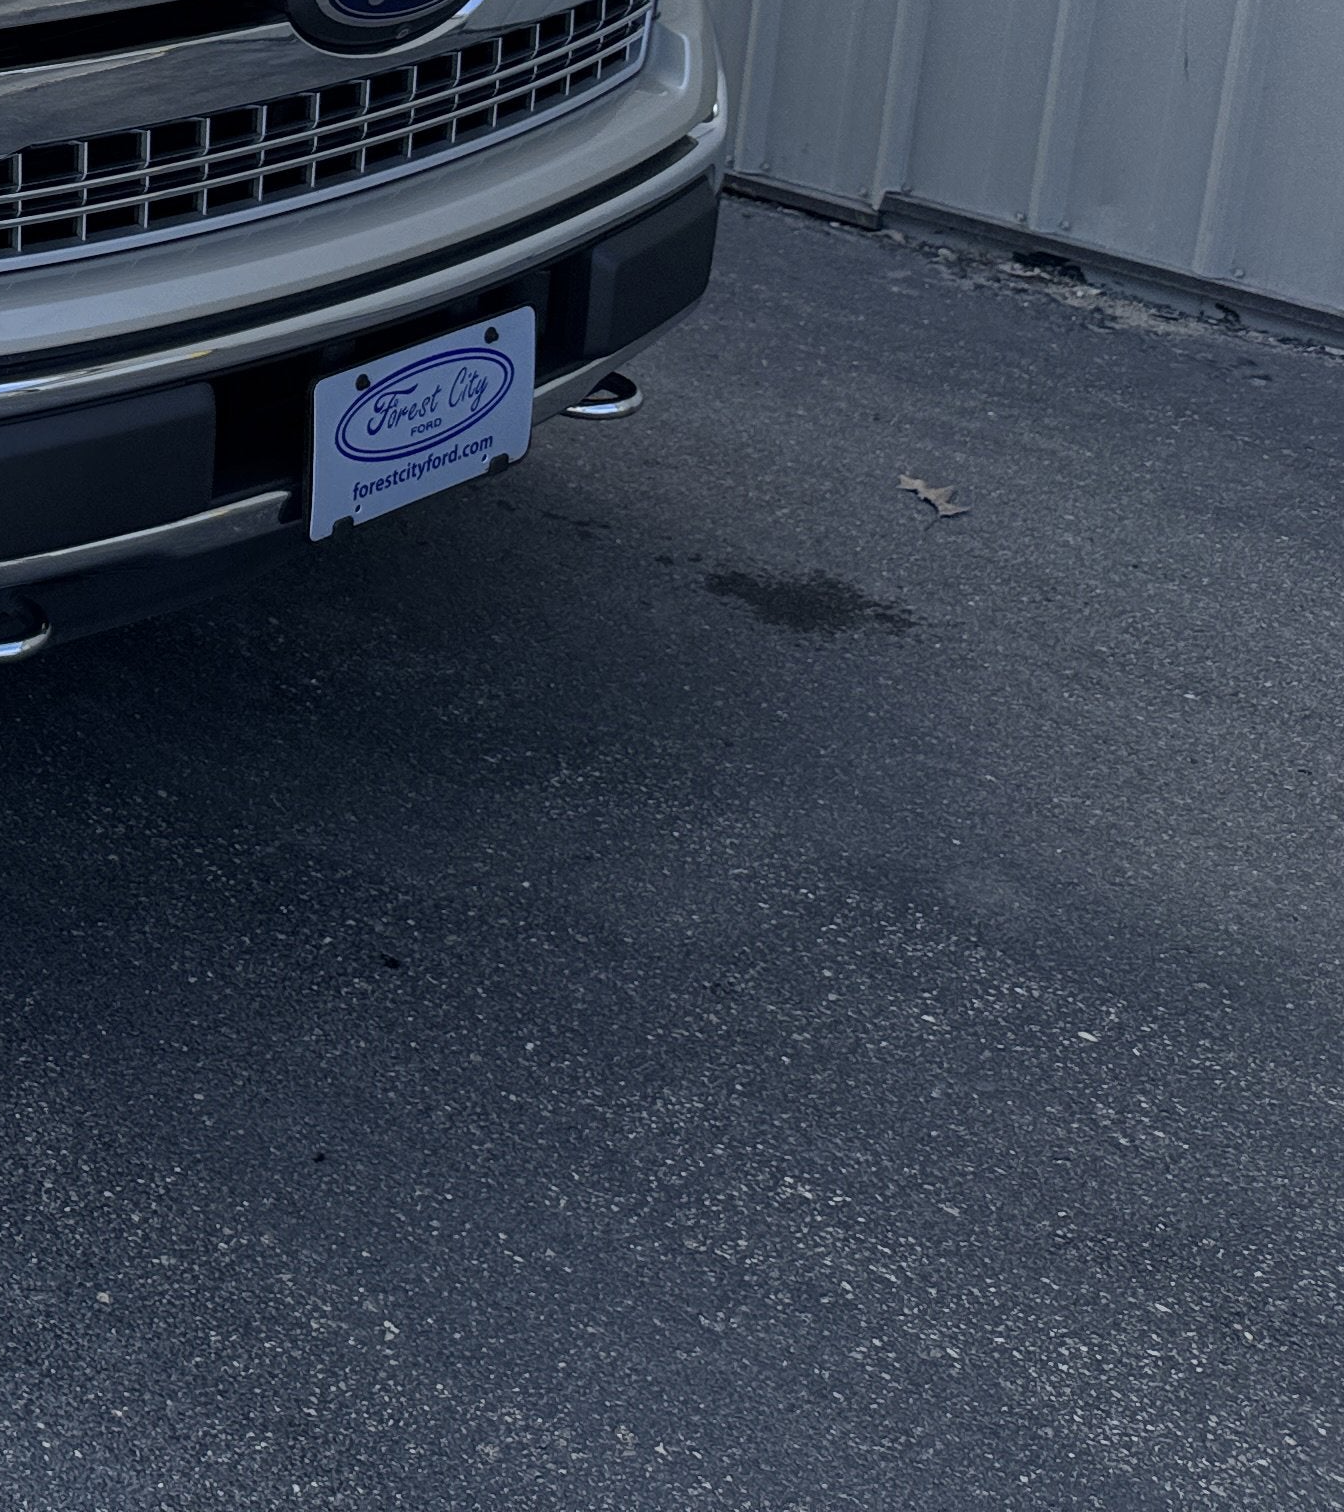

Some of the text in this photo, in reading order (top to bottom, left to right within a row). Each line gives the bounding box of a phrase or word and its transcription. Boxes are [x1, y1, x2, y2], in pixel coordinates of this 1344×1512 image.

[367, 366, 489, 436] Forest City
[410, 417, 443, 437] FORD
[352, 435, 494, 501] forestcityford.com
